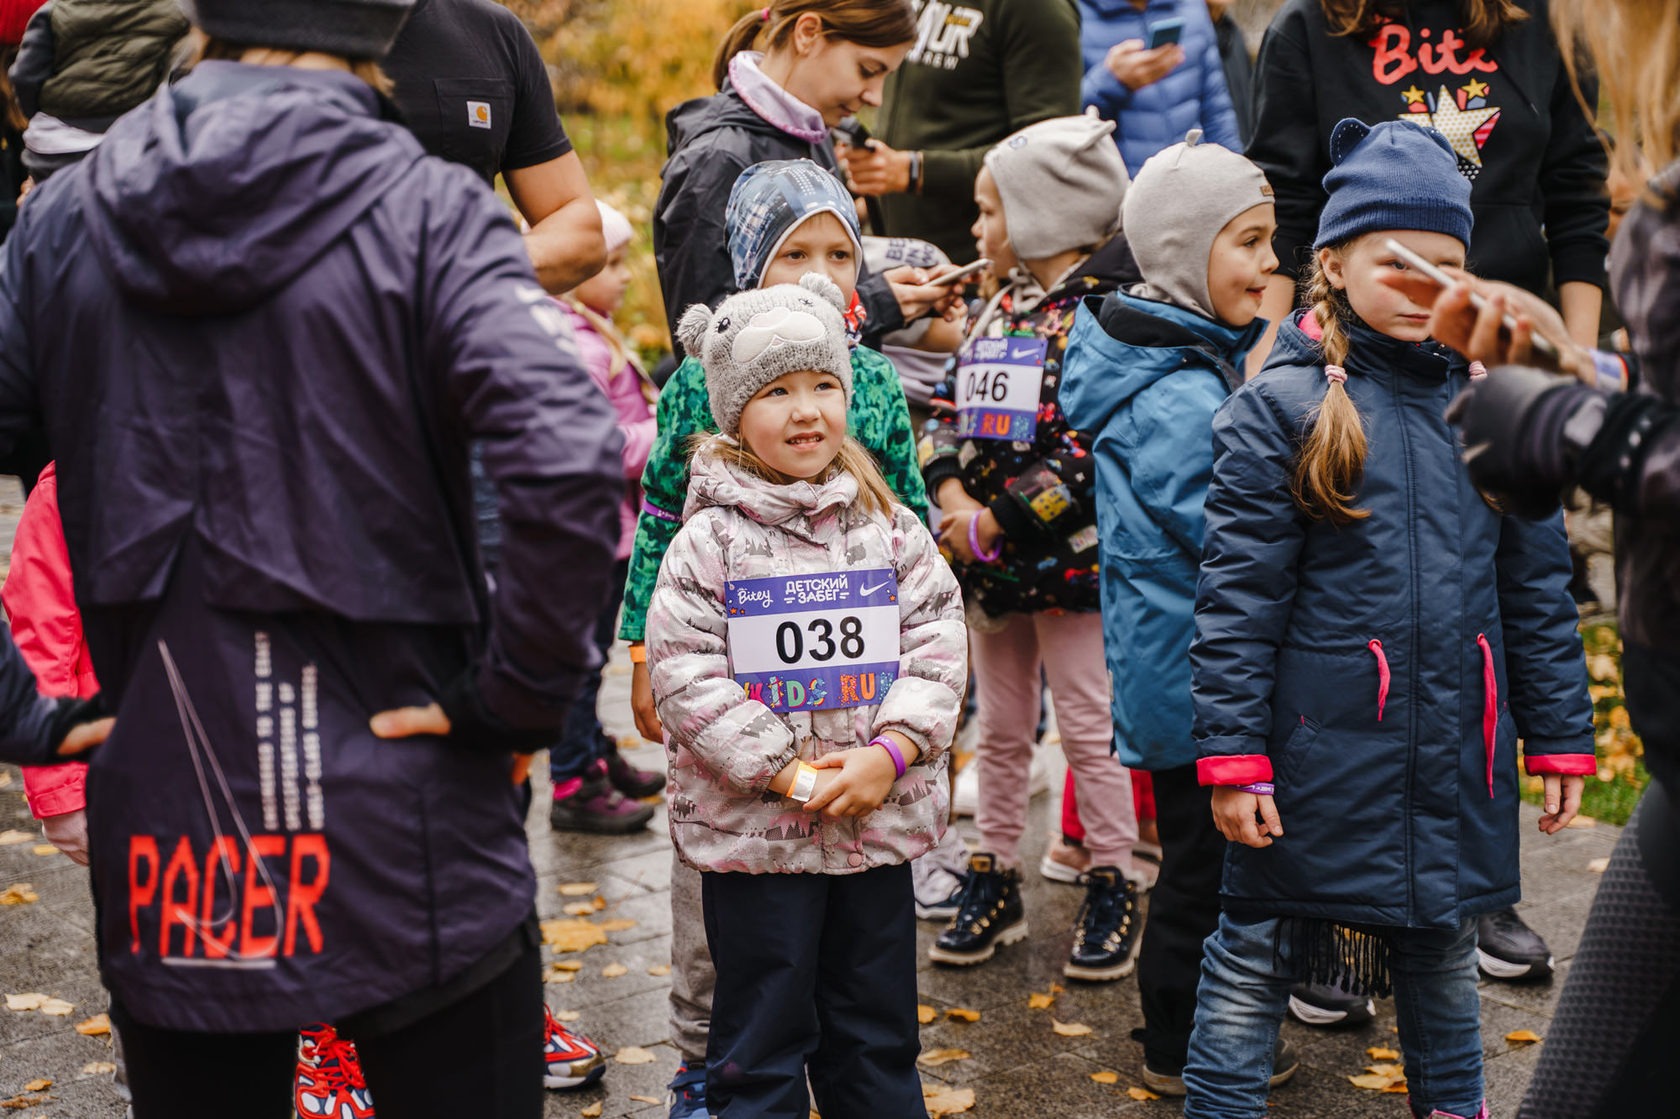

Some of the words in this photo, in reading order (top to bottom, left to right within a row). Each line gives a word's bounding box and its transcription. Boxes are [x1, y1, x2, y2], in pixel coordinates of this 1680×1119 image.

[966, 370, 1010, 402] 046
[785, 574, 849, 595] ДЕТСКИЙ
[798, 589, 840, 605] ЗАБЕГ
[737, 590, 774, 608] Bitey
[775, 616, 865, 665] 038
[128, 833, 331, 958] PACER
